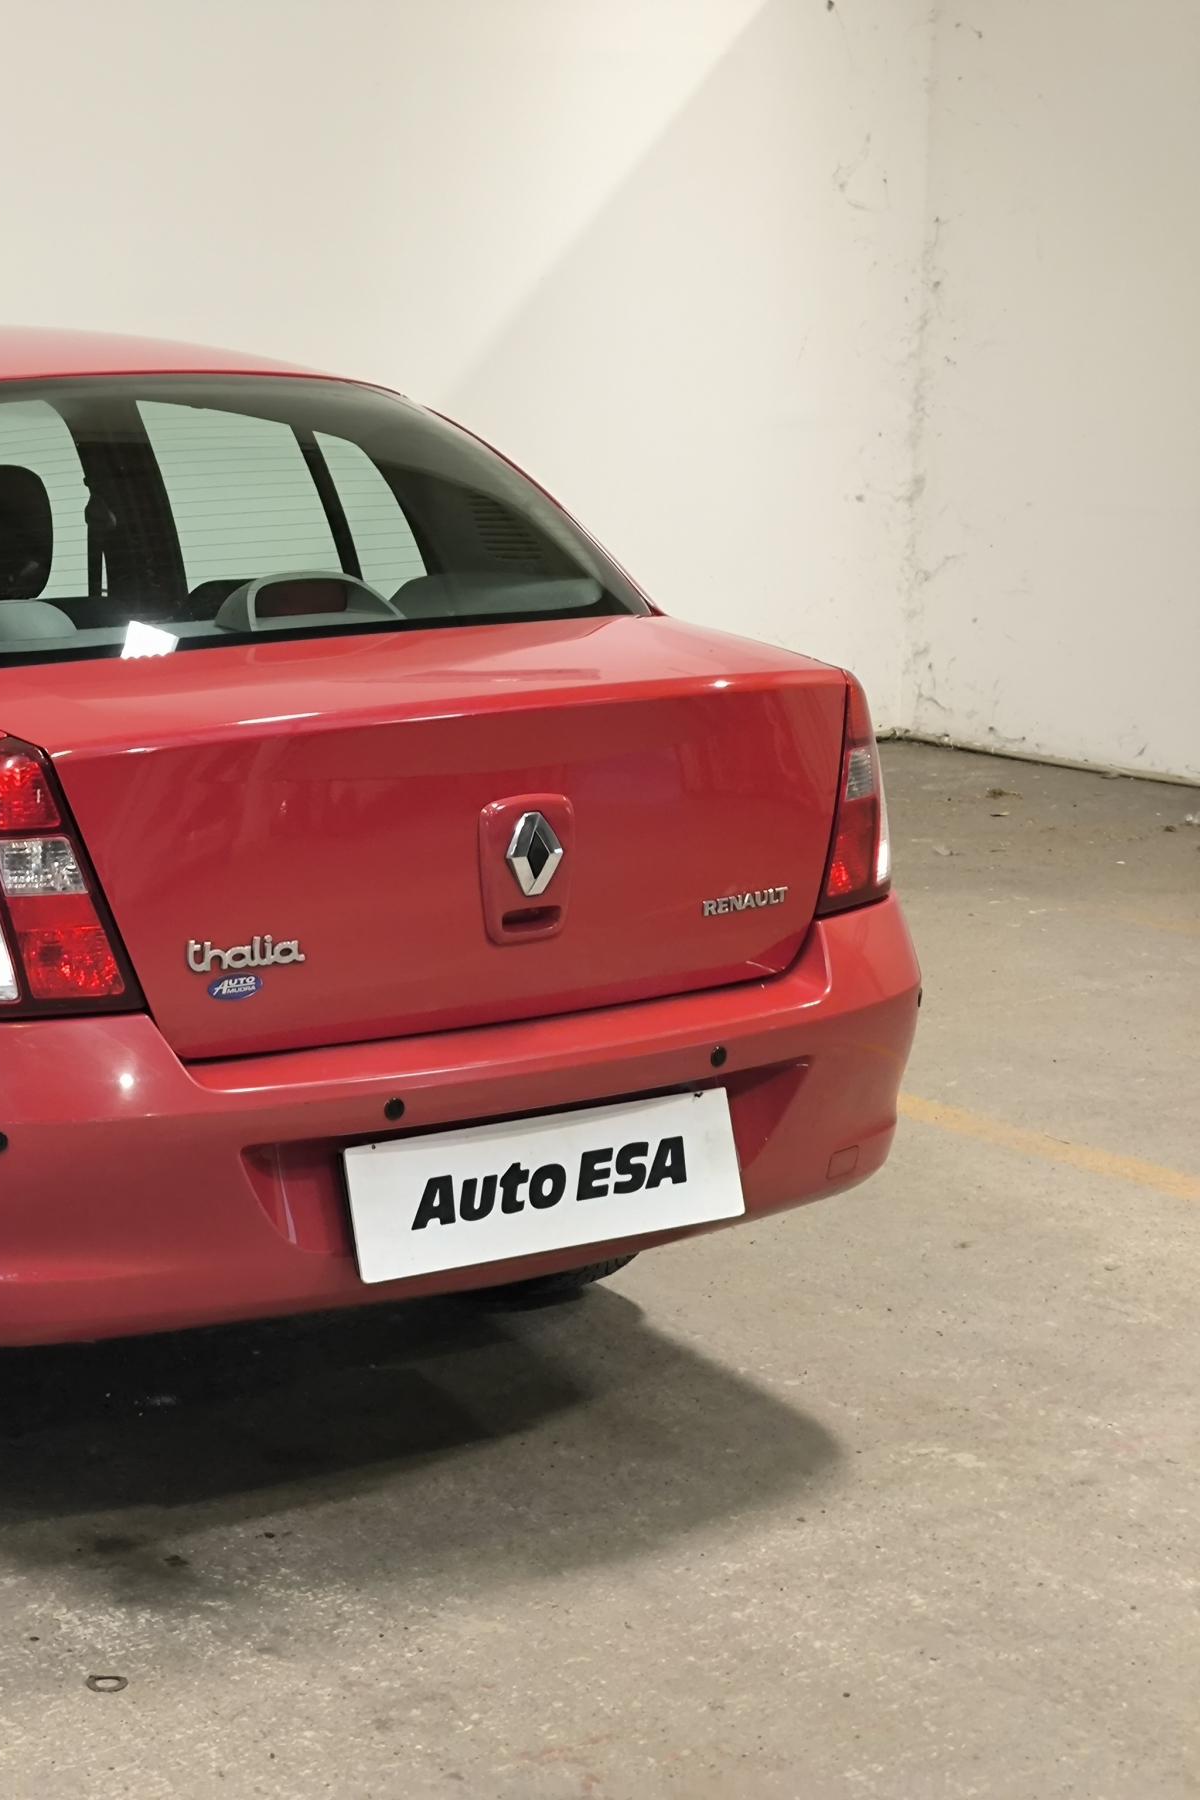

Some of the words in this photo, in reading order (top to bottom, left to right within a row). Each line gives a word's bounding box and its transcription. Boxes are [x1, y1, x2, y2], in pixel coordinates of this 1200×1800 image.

[702, 886, 788, 917] RENAULT
[187, 934, 305, 972] thalia
[212, 976, 256, 996] AUTO
[411, 1162, 567, 1231] Auto
[576, 1135, 687, 1202] ESA
